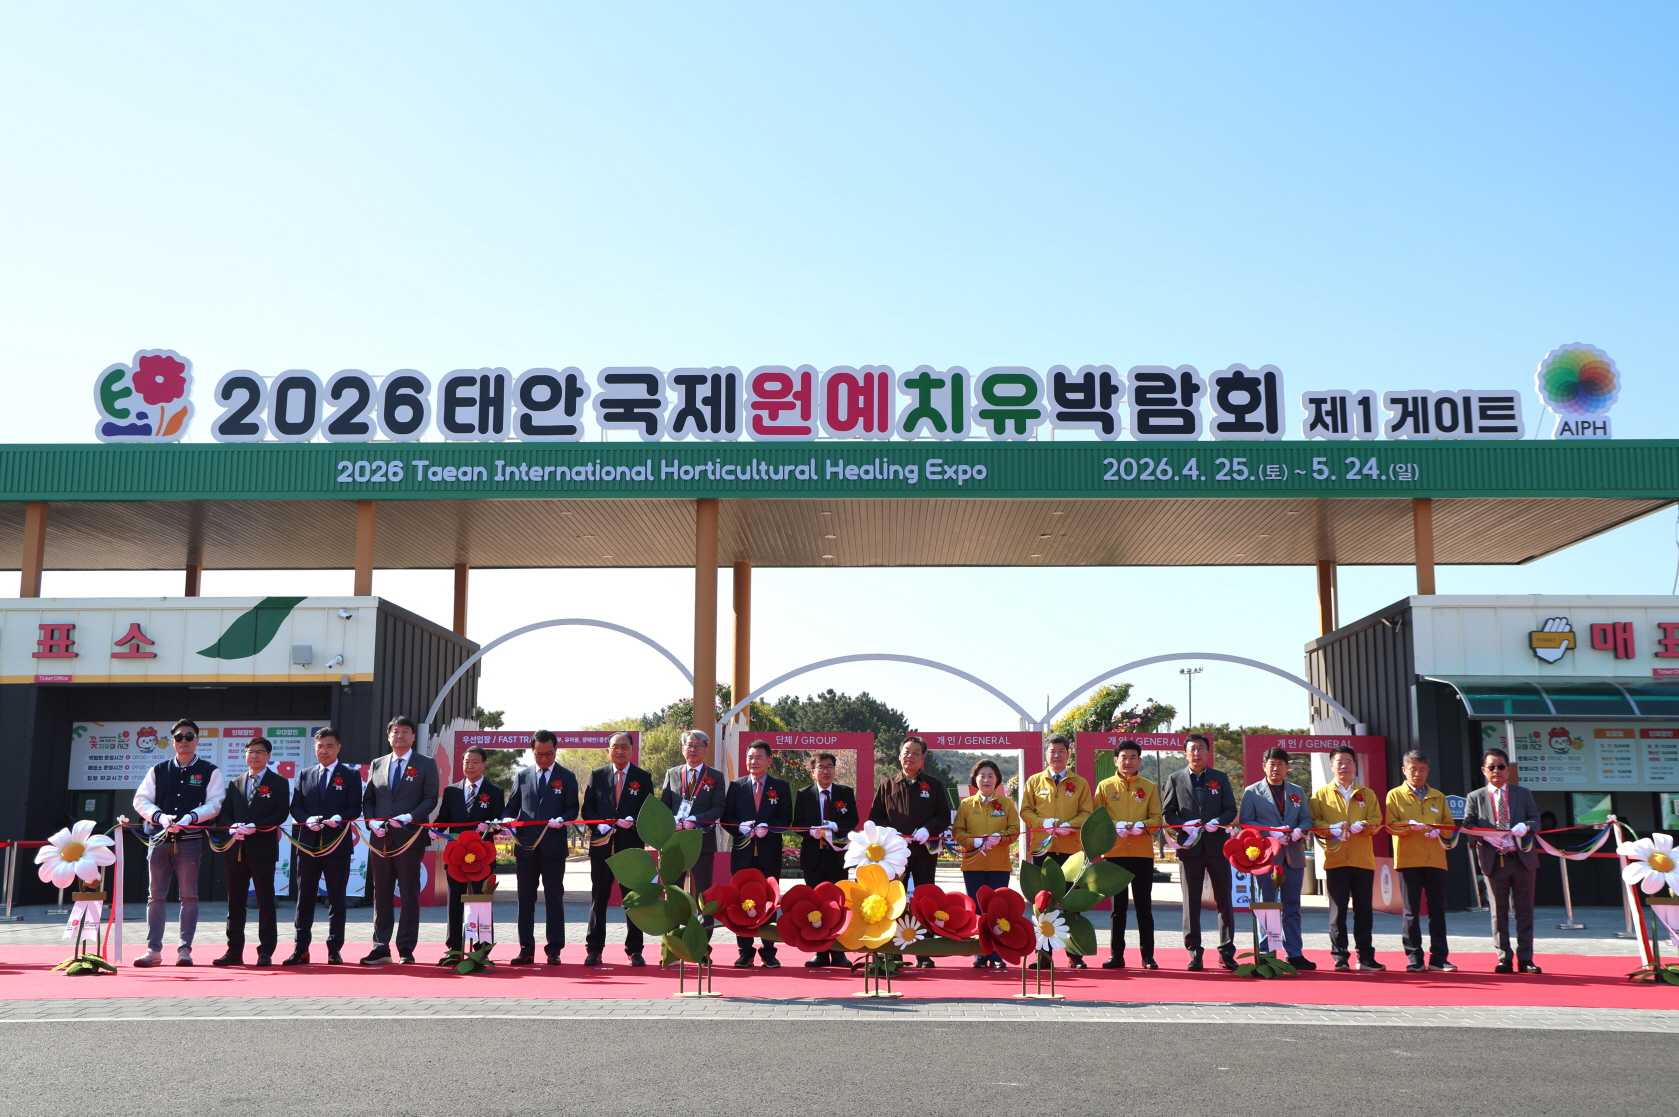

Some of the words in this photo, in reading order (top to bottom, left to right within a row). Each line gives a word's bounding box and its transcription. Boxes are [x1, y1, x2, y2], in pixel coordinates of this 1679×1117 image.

[1389, 396, 1519, 434] 게이트
[1559, 420, 1607, 436] AIPH
[336, 460, 404, 483] 2026
[411, 460, 488, 482] Taean
[494, 459, 655, 482] International
[660, 458, 818, 481] Horticultural
[826, 457, 919, 484] Healing
[925, 458, 987, 486] Expo
[498, 735, 518, 744] FAST
[775, 735, 793, 745] 단체
[801, 736, 838, 745] GROUP
[964, 736, 1012, 745] GENERAL
[1135, 737, 1183, 747] GENERAL
[1305, 739, 1354, 749] GENERAL
